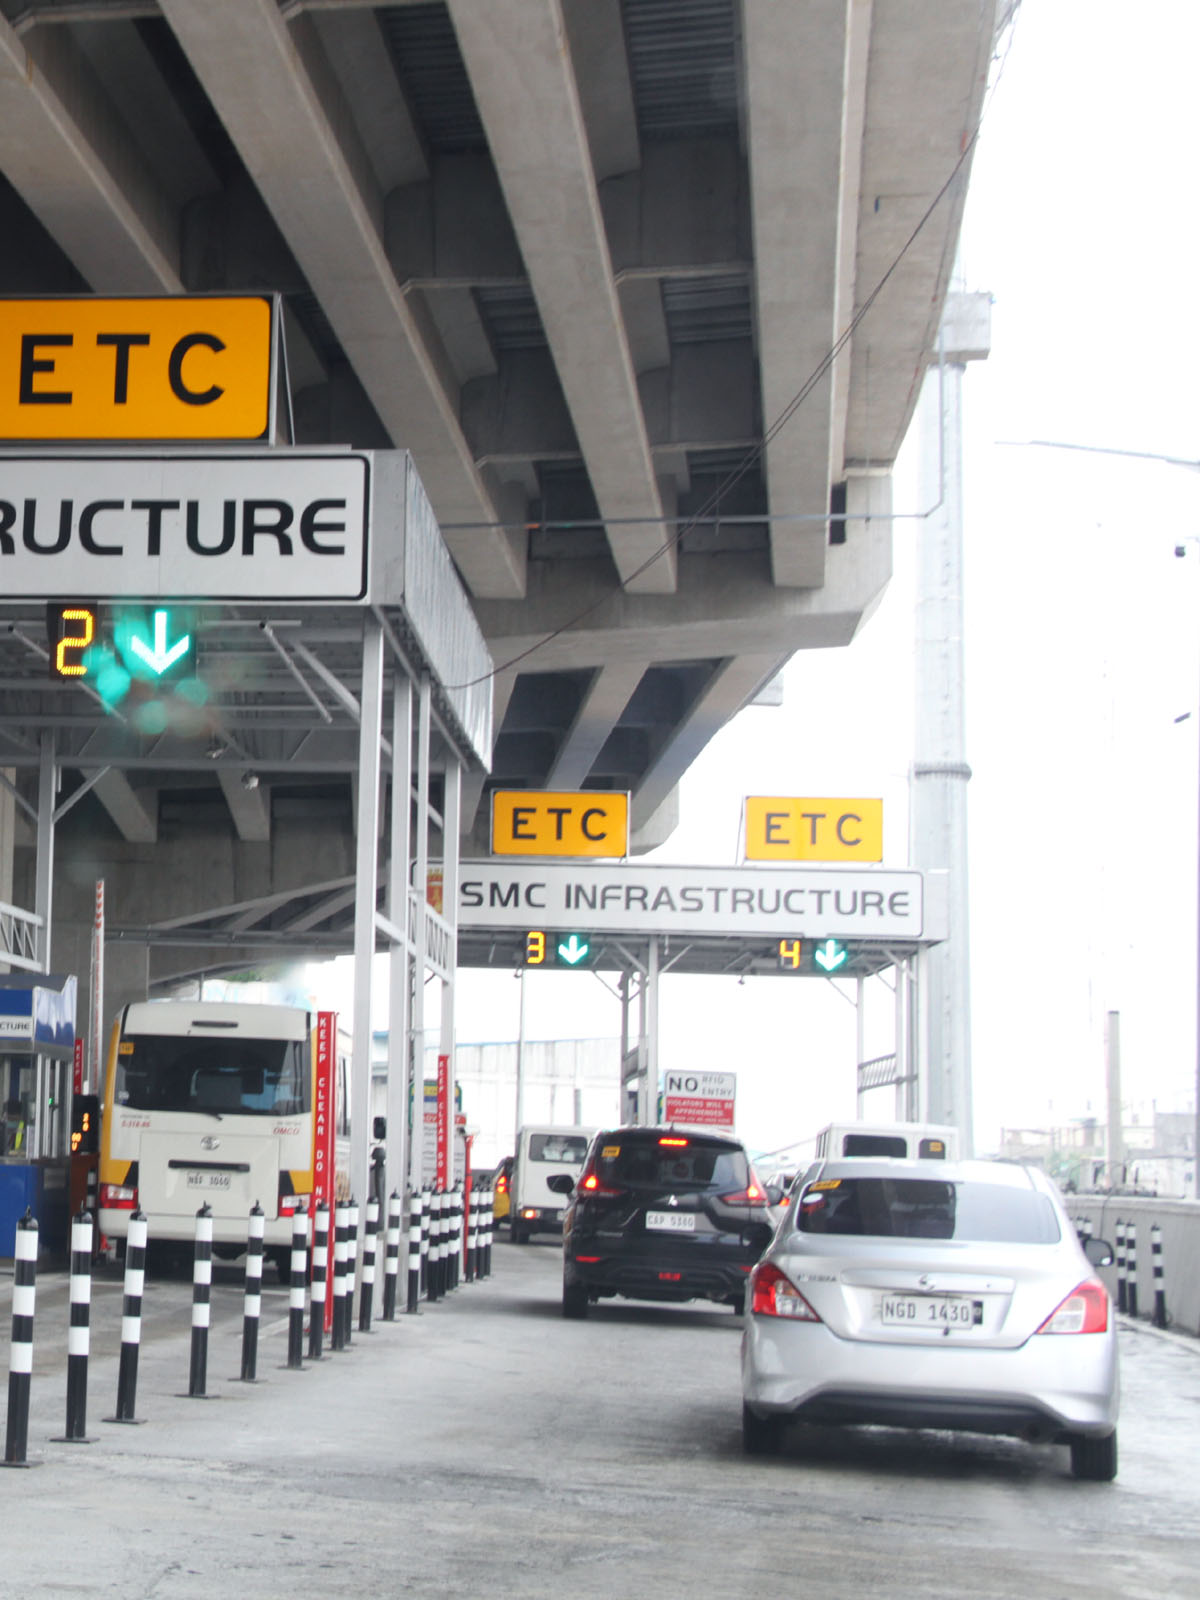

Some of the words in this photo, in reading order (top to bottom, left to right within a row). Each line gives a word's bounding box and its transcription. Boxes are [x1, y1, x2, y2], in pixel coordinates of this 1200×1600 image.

[19, 332, 227, 406] ETC
[56, 609, 93, 676] 2
[511, 807, 608, 842] ETC
[765, 812, 863, 847] ETC
[460, 881, 547, 908] SMC
[565, 883, 911, 918] INFRASTRUCTURE
[527, 931, 545, 965] 3
[780, 939, 801, 969] 4
[319, 1017, 327, 1063] KEEP
[669, 1077, 698, 1092] NO
[317, 1077, 326, 1136] CLEAR
[316, 1151, 323, 1172] DO
[884, 1302, 916, 1320] NGD
[928, 1304, 970, 1322] 1430
